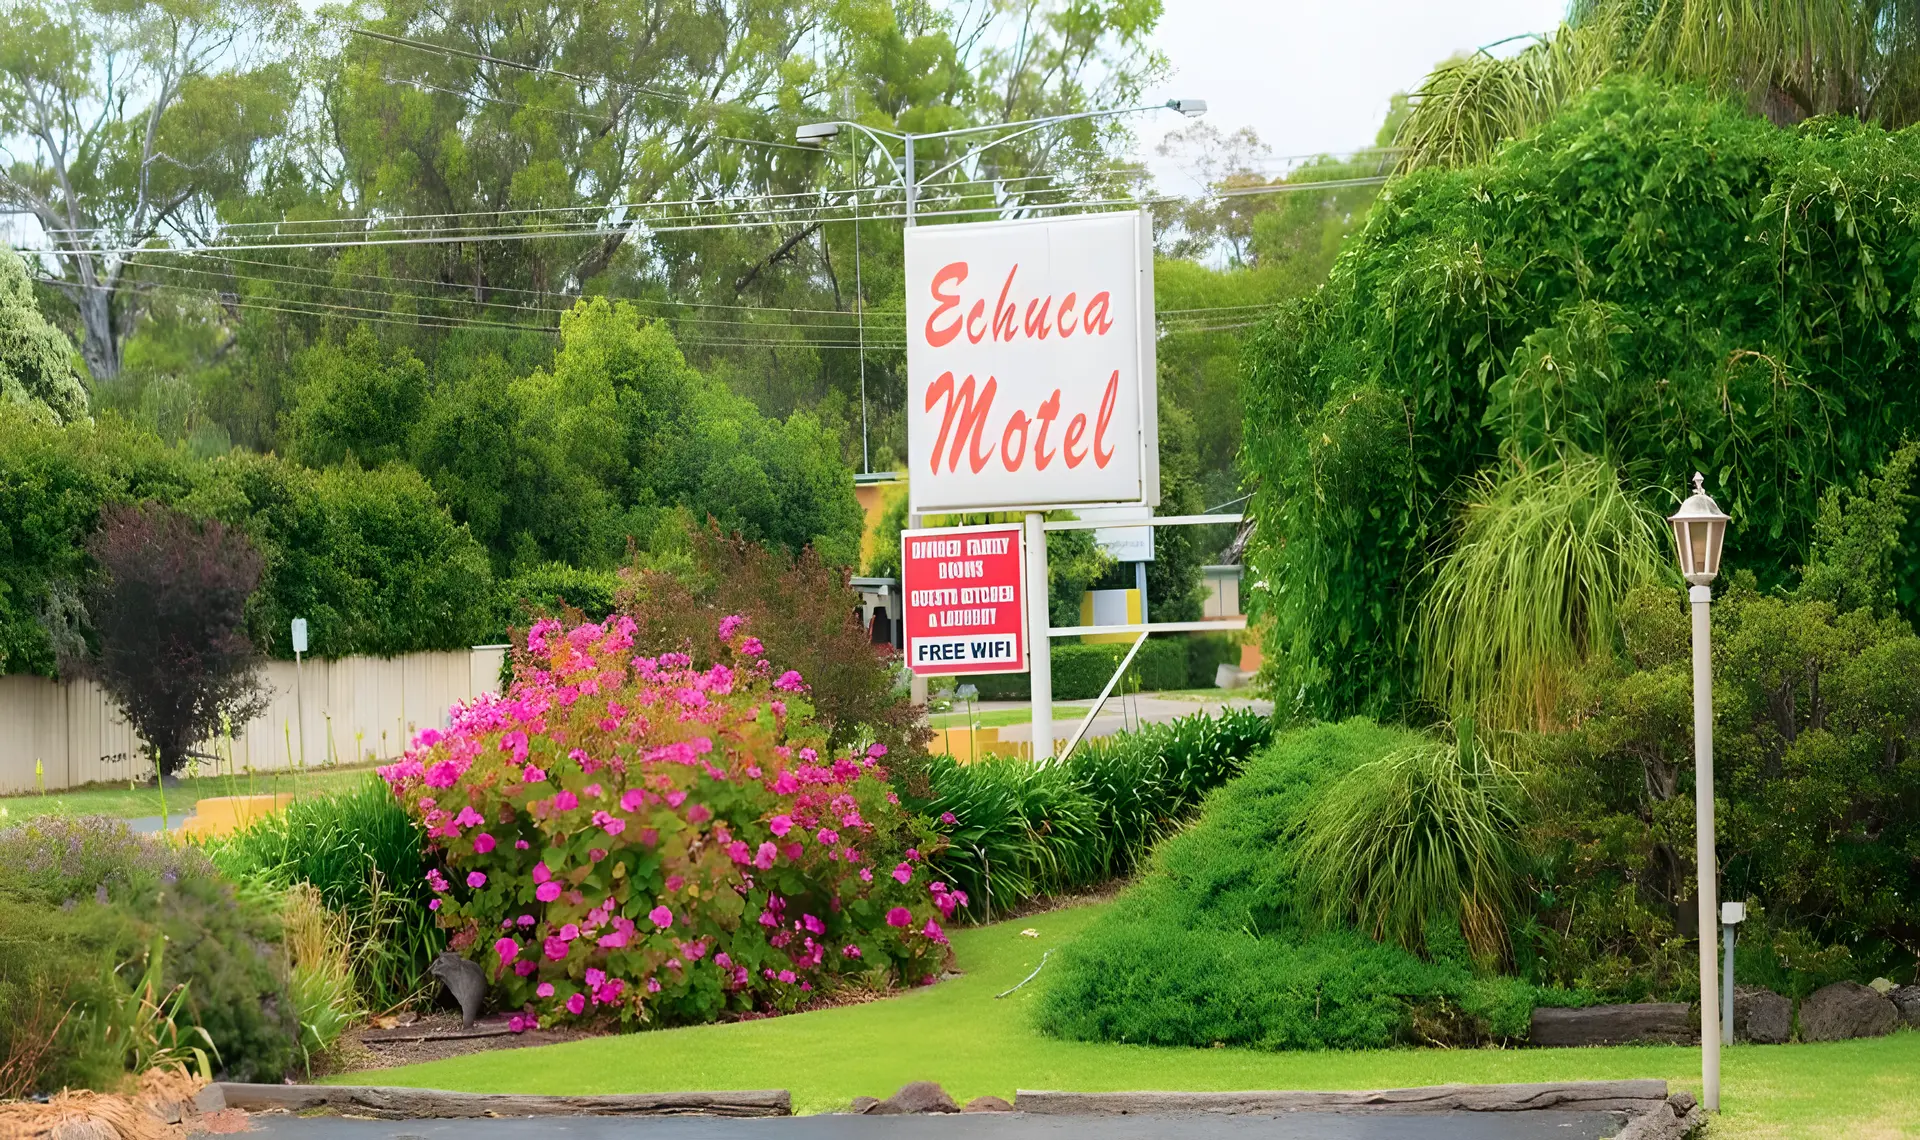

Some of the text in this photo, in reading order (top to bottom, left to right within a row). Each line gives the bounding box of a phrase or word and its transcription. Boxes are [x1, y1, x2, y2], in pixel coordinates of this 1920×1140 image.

[924, 261, 1114, 348] Echuca
[924, 369, 1120, 476] Motel
[919, 641, 1011, 661] FREE WIFI
